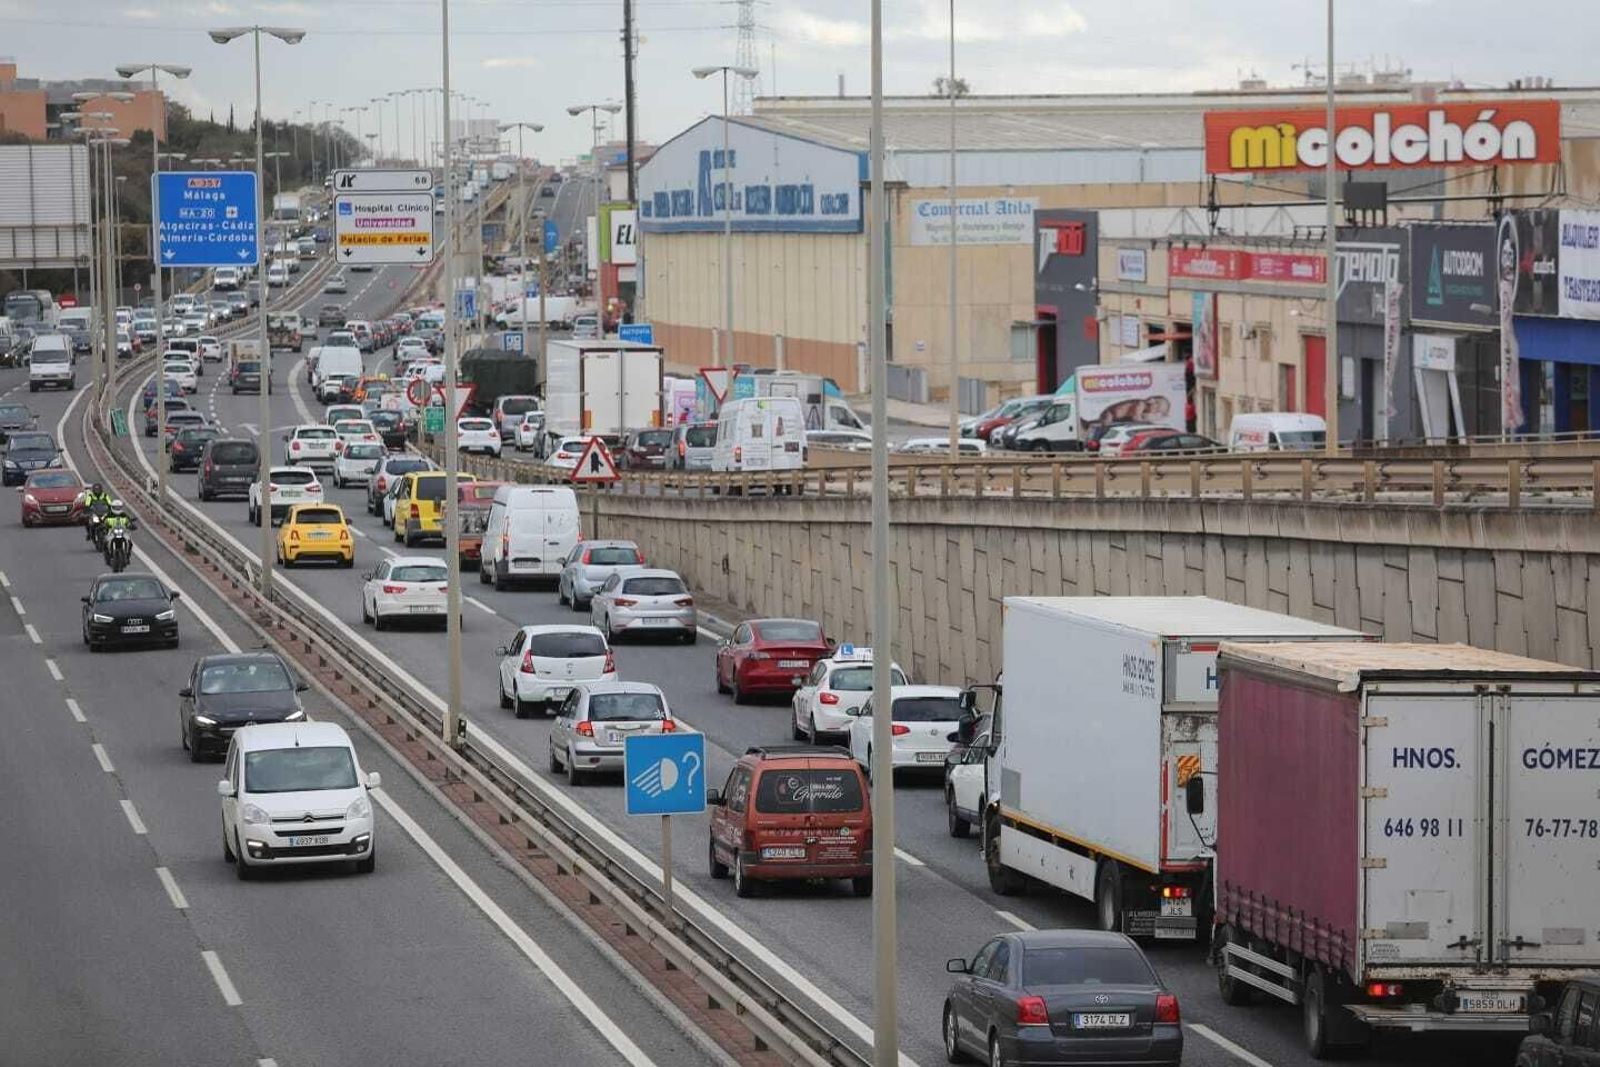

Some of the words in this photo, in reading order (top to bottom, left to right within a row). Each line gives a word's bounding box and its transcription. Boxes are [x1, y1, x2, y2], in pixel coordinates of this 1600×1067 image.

[1230, 109, 1537, 168] micolchón
[183, 190, 226, 201] Málaga
[354, 203, 393, 213] Hospital
[996, 200, 1031, 215] Atila
[356, 217, 413, 228] Universidad
[341, 235, 377, 244] Palacio
[381, 235, 393, 243] de
[397, 234, 428, 243] Ferias
[1561, 224, 1599, 250] ALQUILER
[1442, 250, 1484, 277] AUTODROM
[1084, 376, 1150, 387] micolchón
[1392, 747, 1461, 769] HNOS.
[1522, 742, 1600, 770] GÓMEZ
[1384, 818, 1414, 837] 646
[1420, 818, 1440, 837] 98
[1448, 818, 1463, 837] 11
[1525, 818, 1598, 838] 76-77-78
[1469, 999, 1494, 1009] 5859
[1497, 1000, 1515, 1009] DLH
[1083, 1015, 1106, 1025] 3174
